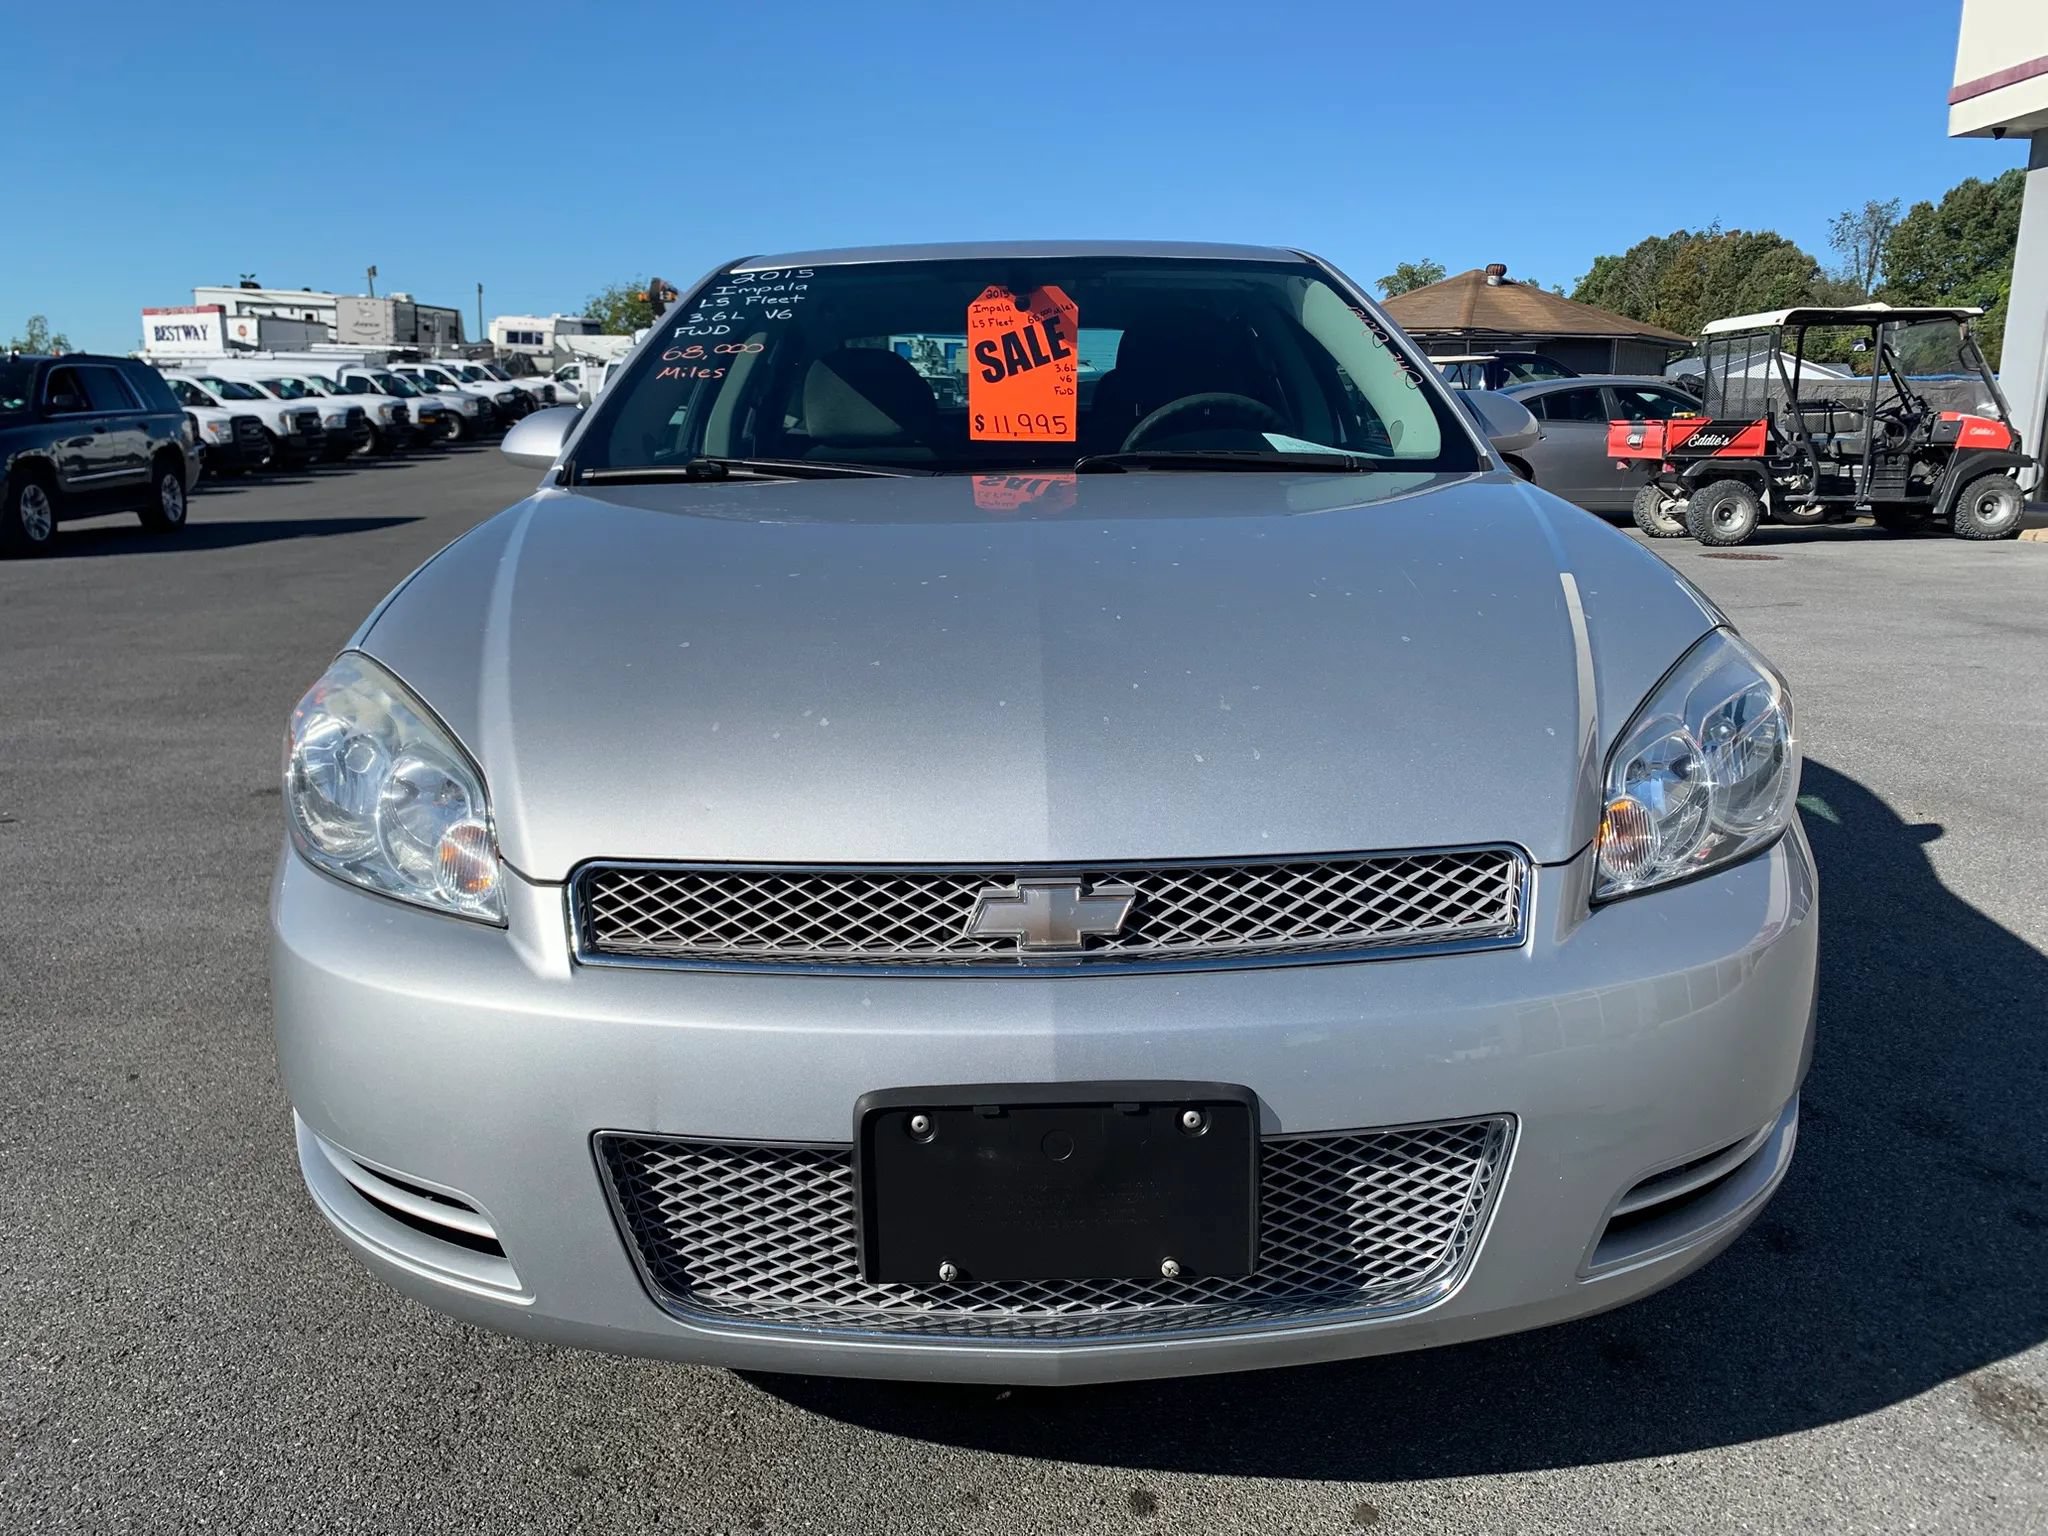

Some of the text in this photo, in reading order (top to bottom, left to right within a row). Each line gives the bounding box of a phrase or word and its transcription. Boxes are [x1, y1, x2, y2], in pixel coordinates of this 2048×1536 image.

[732, 268, 815, 285] 2015
[712, 283, 808, 297] Impala
[699, 294, 806, 309] LS Fleet
[973, 303, 1011, 315] Impala
[688, 308, 793, 324] 3.6L V6
[972, 316, 1014, 329] LS Fleet
[154, 324, 209, 342] BESTWAY
[673, 324, 731, 339] FWD
[662, 342, 765, 362] 68,000
[975, 315, 1072, 384] SALE
[656, 366, 726, 381] Miles
[1055, 363, 1077, 373] 3.6L
[1687, 433, 1730, 447] Eddie's
